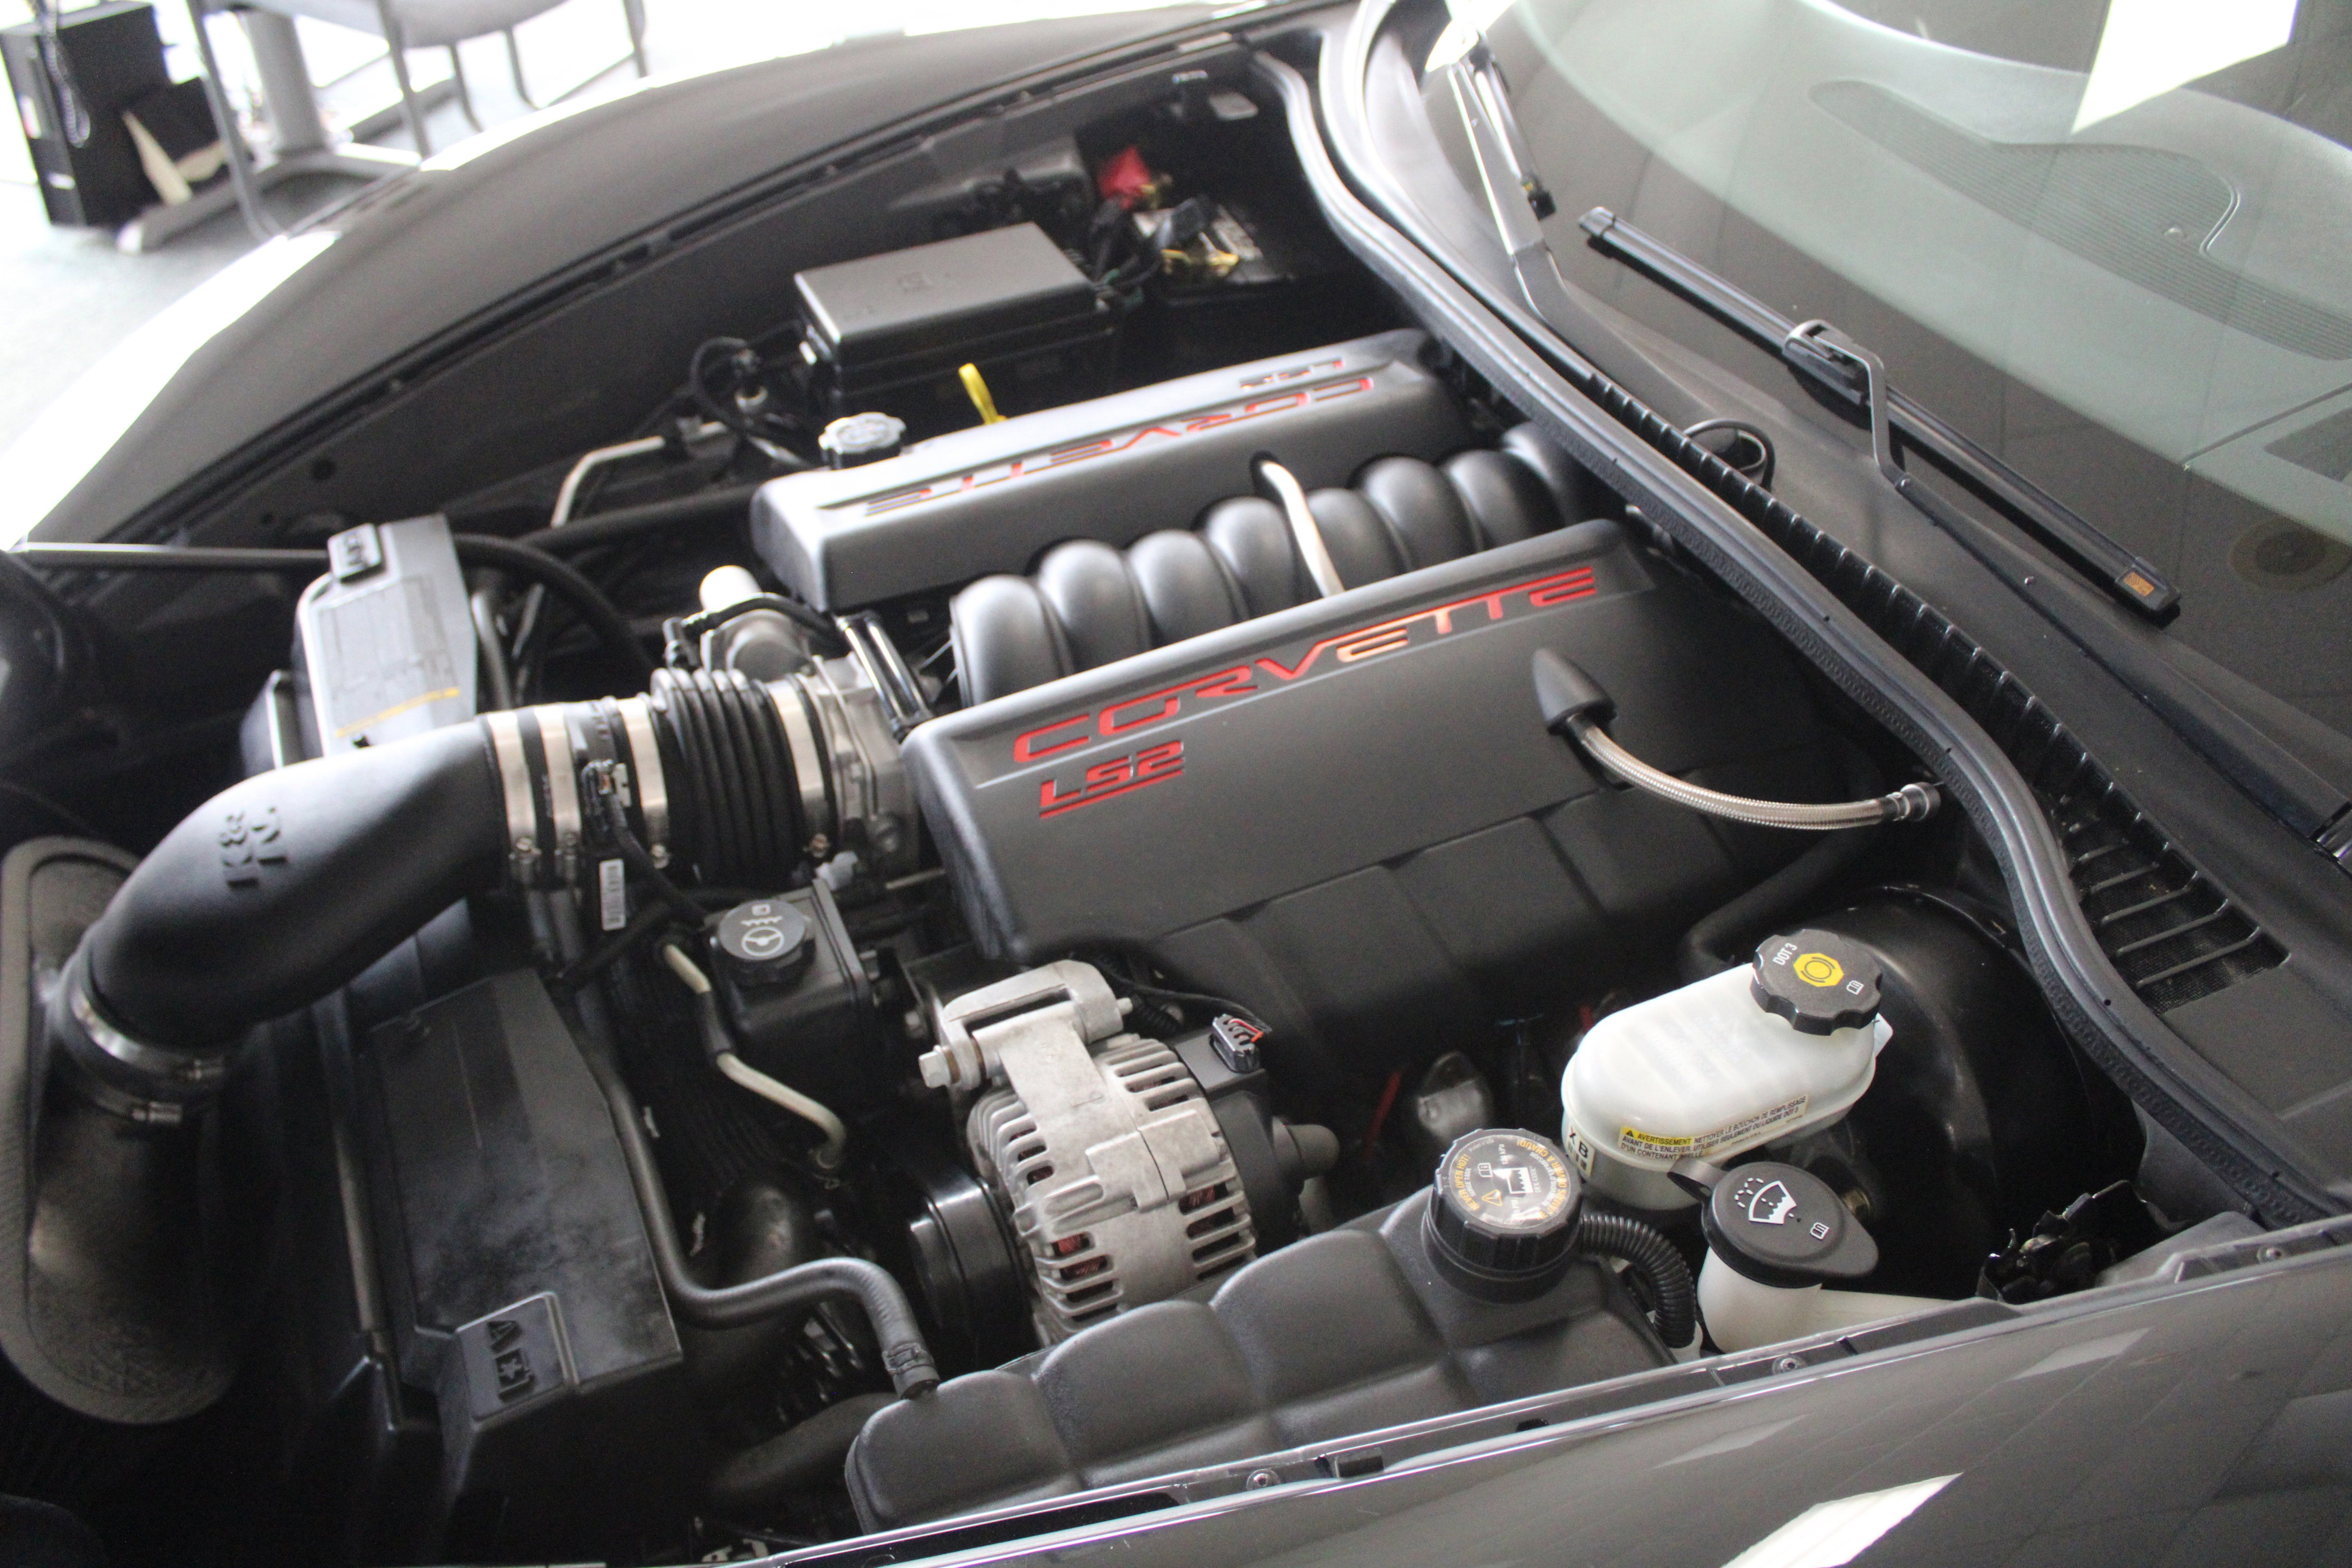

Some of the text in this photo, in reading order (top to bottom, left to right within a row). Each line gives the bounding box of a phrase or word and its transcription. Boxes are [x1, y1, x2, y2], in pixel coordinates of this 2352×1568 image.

[864, 378, 1373, 518] CORVETTE
[1013, 566, 1597, 763] CORVETTE
[1040, 740, 1184, 813] LS2
[1773, 946, 1793, 965] DOT
[1622, 1136, 1643, 1147] AVANT
[1638, 1133, 1692, 1145] AVERTISSEMENT
[1725, 1126, 1732, 1134] LE
[1621, 1143, 1635, 1154] D'UN
[1637, 1149, 1678, 1159] CONTENANT
[1454, 1154, 1480, 1211] NEVER OPEN HOT!
[1552, 1162, 1567, 1189] OUVRIR
[1465, 1181, 1476, 1197] SURGE
[1547, 1189, 1567, 1215] JAMAIS
